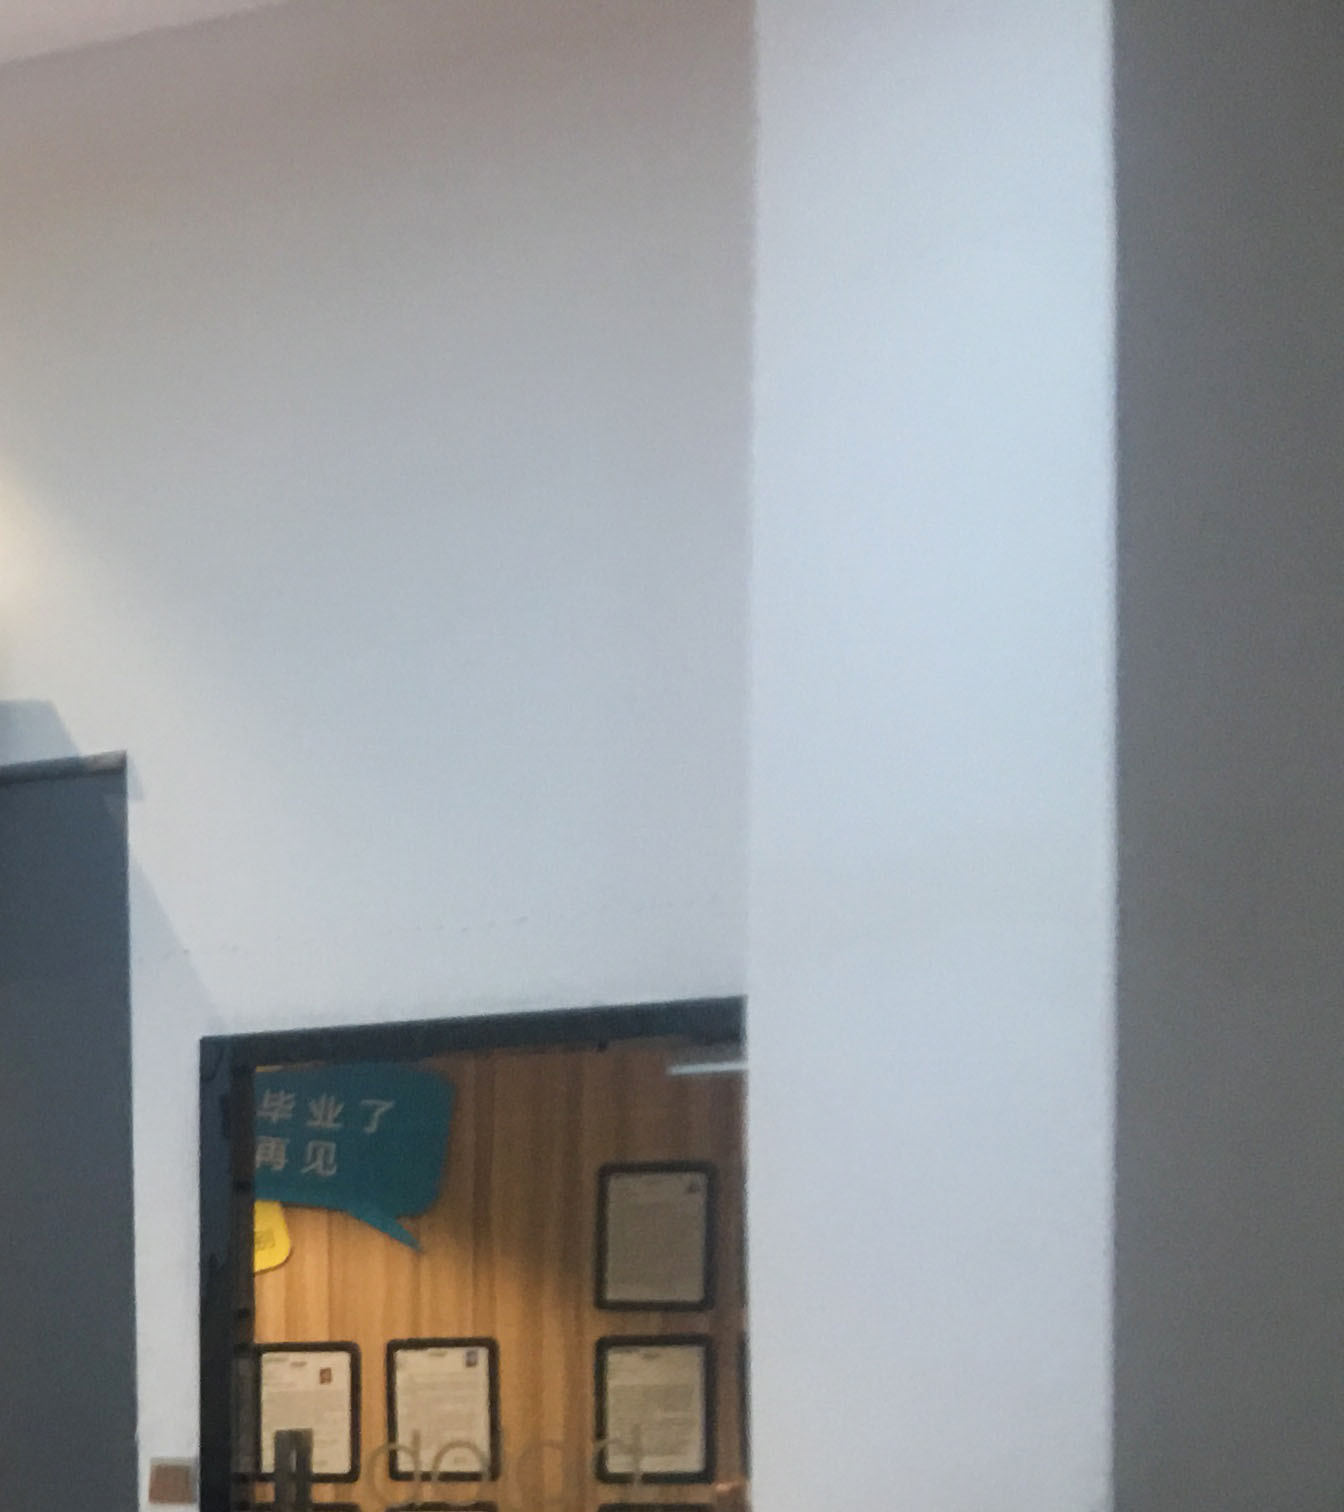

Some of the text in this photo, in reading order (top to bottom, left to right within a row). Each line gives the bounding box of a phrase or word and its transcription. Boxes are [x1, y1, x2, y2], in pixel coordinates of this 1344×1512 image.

[255, 1088, 397, 1135] 毕业了
[255, 1135, 339, 1177] 再见
